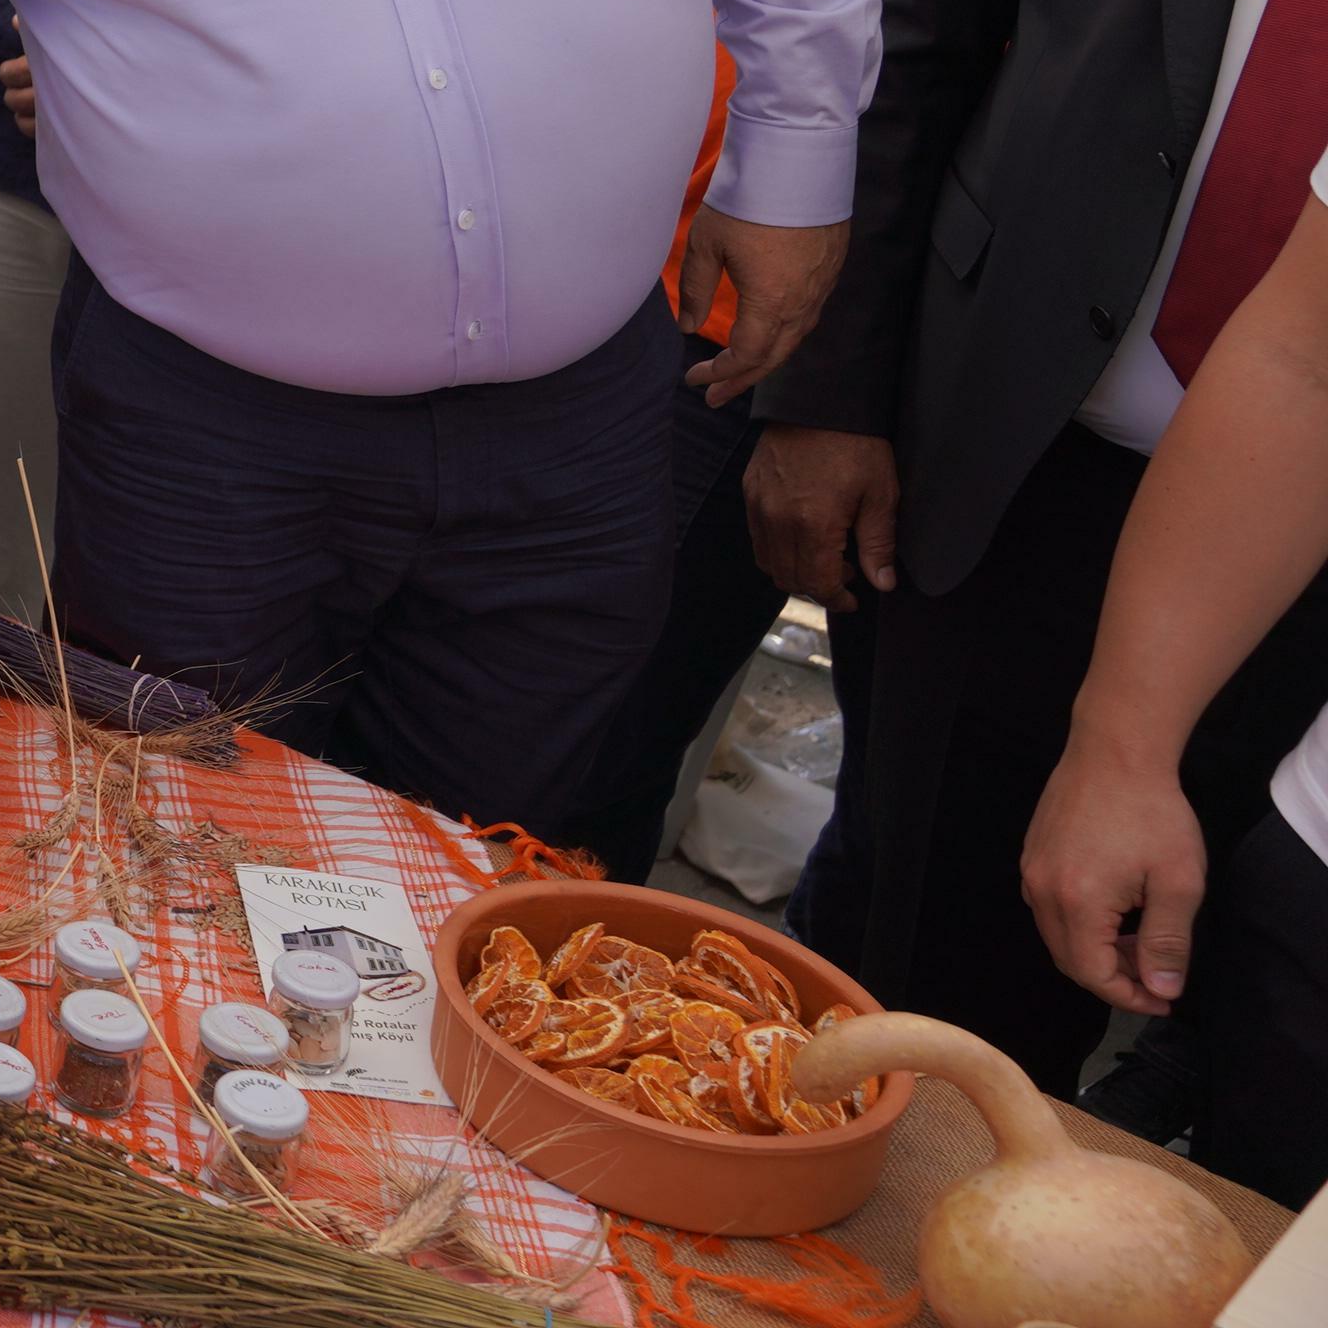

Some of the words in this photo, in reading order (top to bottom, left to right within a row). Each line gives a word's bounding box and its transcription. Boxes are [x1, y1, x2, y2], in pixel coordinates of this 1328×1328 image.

[264, 873, 386, 899] KARAKILÇIK
[291, 892, 368, 912] ROTASI
[363, 1019, 418, 1030] Rotalar
[377, 1032, 414, 1043] Köyü
[232, 1077, 283, 1093] KAVUN
